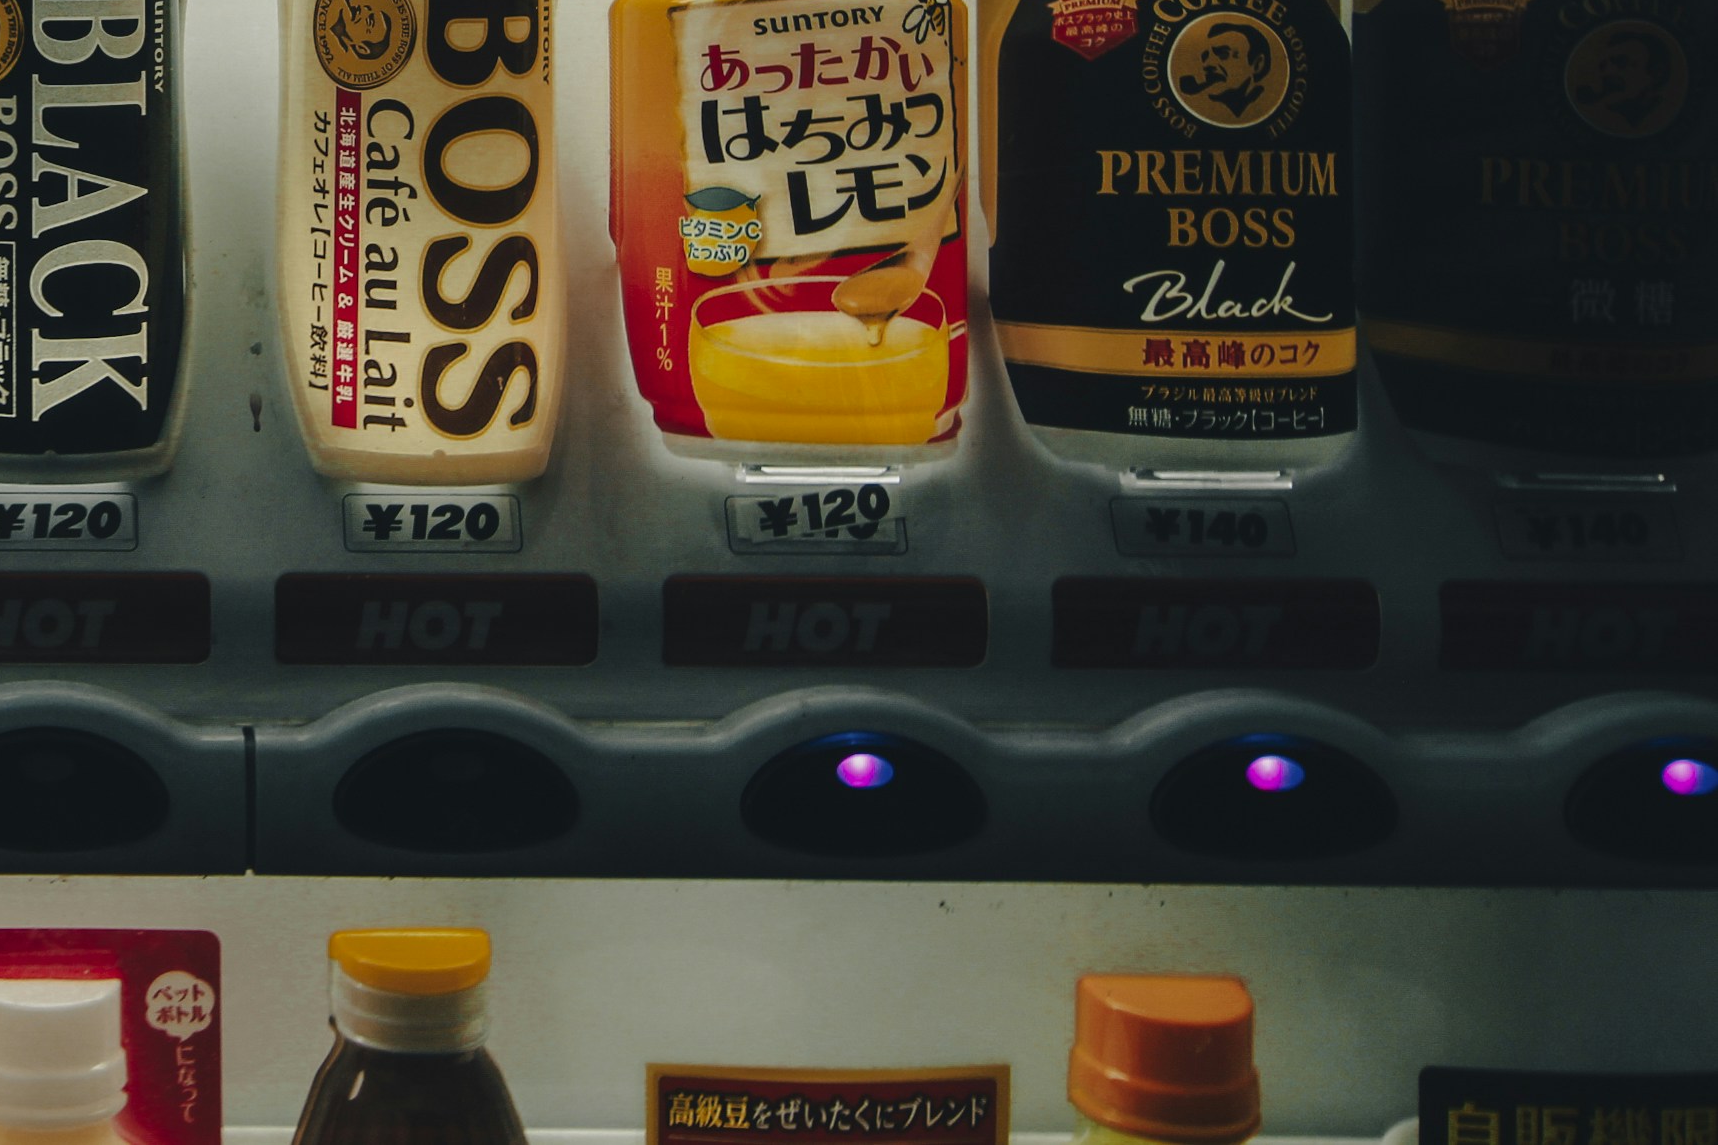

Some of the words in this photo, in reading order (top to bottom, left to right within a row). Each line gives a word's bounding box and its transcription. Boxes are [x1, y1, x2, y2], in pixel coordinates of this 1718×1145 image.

[401, 16, 410, 38] THE
[753, 5, 884, 36] SUNTORY
[392, 38, 410, 64] BOSS
[700, 35, 934, 93] あったかい
[701, 93, 944, 165] はちみつ
[365, 98, 418, 227] Café
[1096, 150, 1338, 195] PREMIUM
[786, 154, 947, 236] レモン
[308, 110, 332, 392] カフェオレ【コーヒー飲料】
[679, 217, 762, 241] ビタミンC
[1167, 208, 1296, 248] BOSS
[1558, 221, 1688, 264] BOSS
[686, 242, 749, 264] たっぷり
[364, 243, 399, 310] au
[1122, 259, 1333, 322] Black
[655, 267, 674, 371] 果汁1%
[1569, 278, 1677, 326] 微糖
[1142, 338, 1321, 369] 最高峰のコク
[362, 329, 415, 433] Lait
[362, 503, 501, 542] ¥120
[1146, 506, 1268, 548] ¥140
[356, 601, 503, 650] HOT
[742, 602, 893, 652] HOT
[154, 1006, 206, 1025] ボトル
[176, 1046, 198, 1123] になって
[668, 1093, 987, 1131] 高級豆をぜいたくにブレンド
